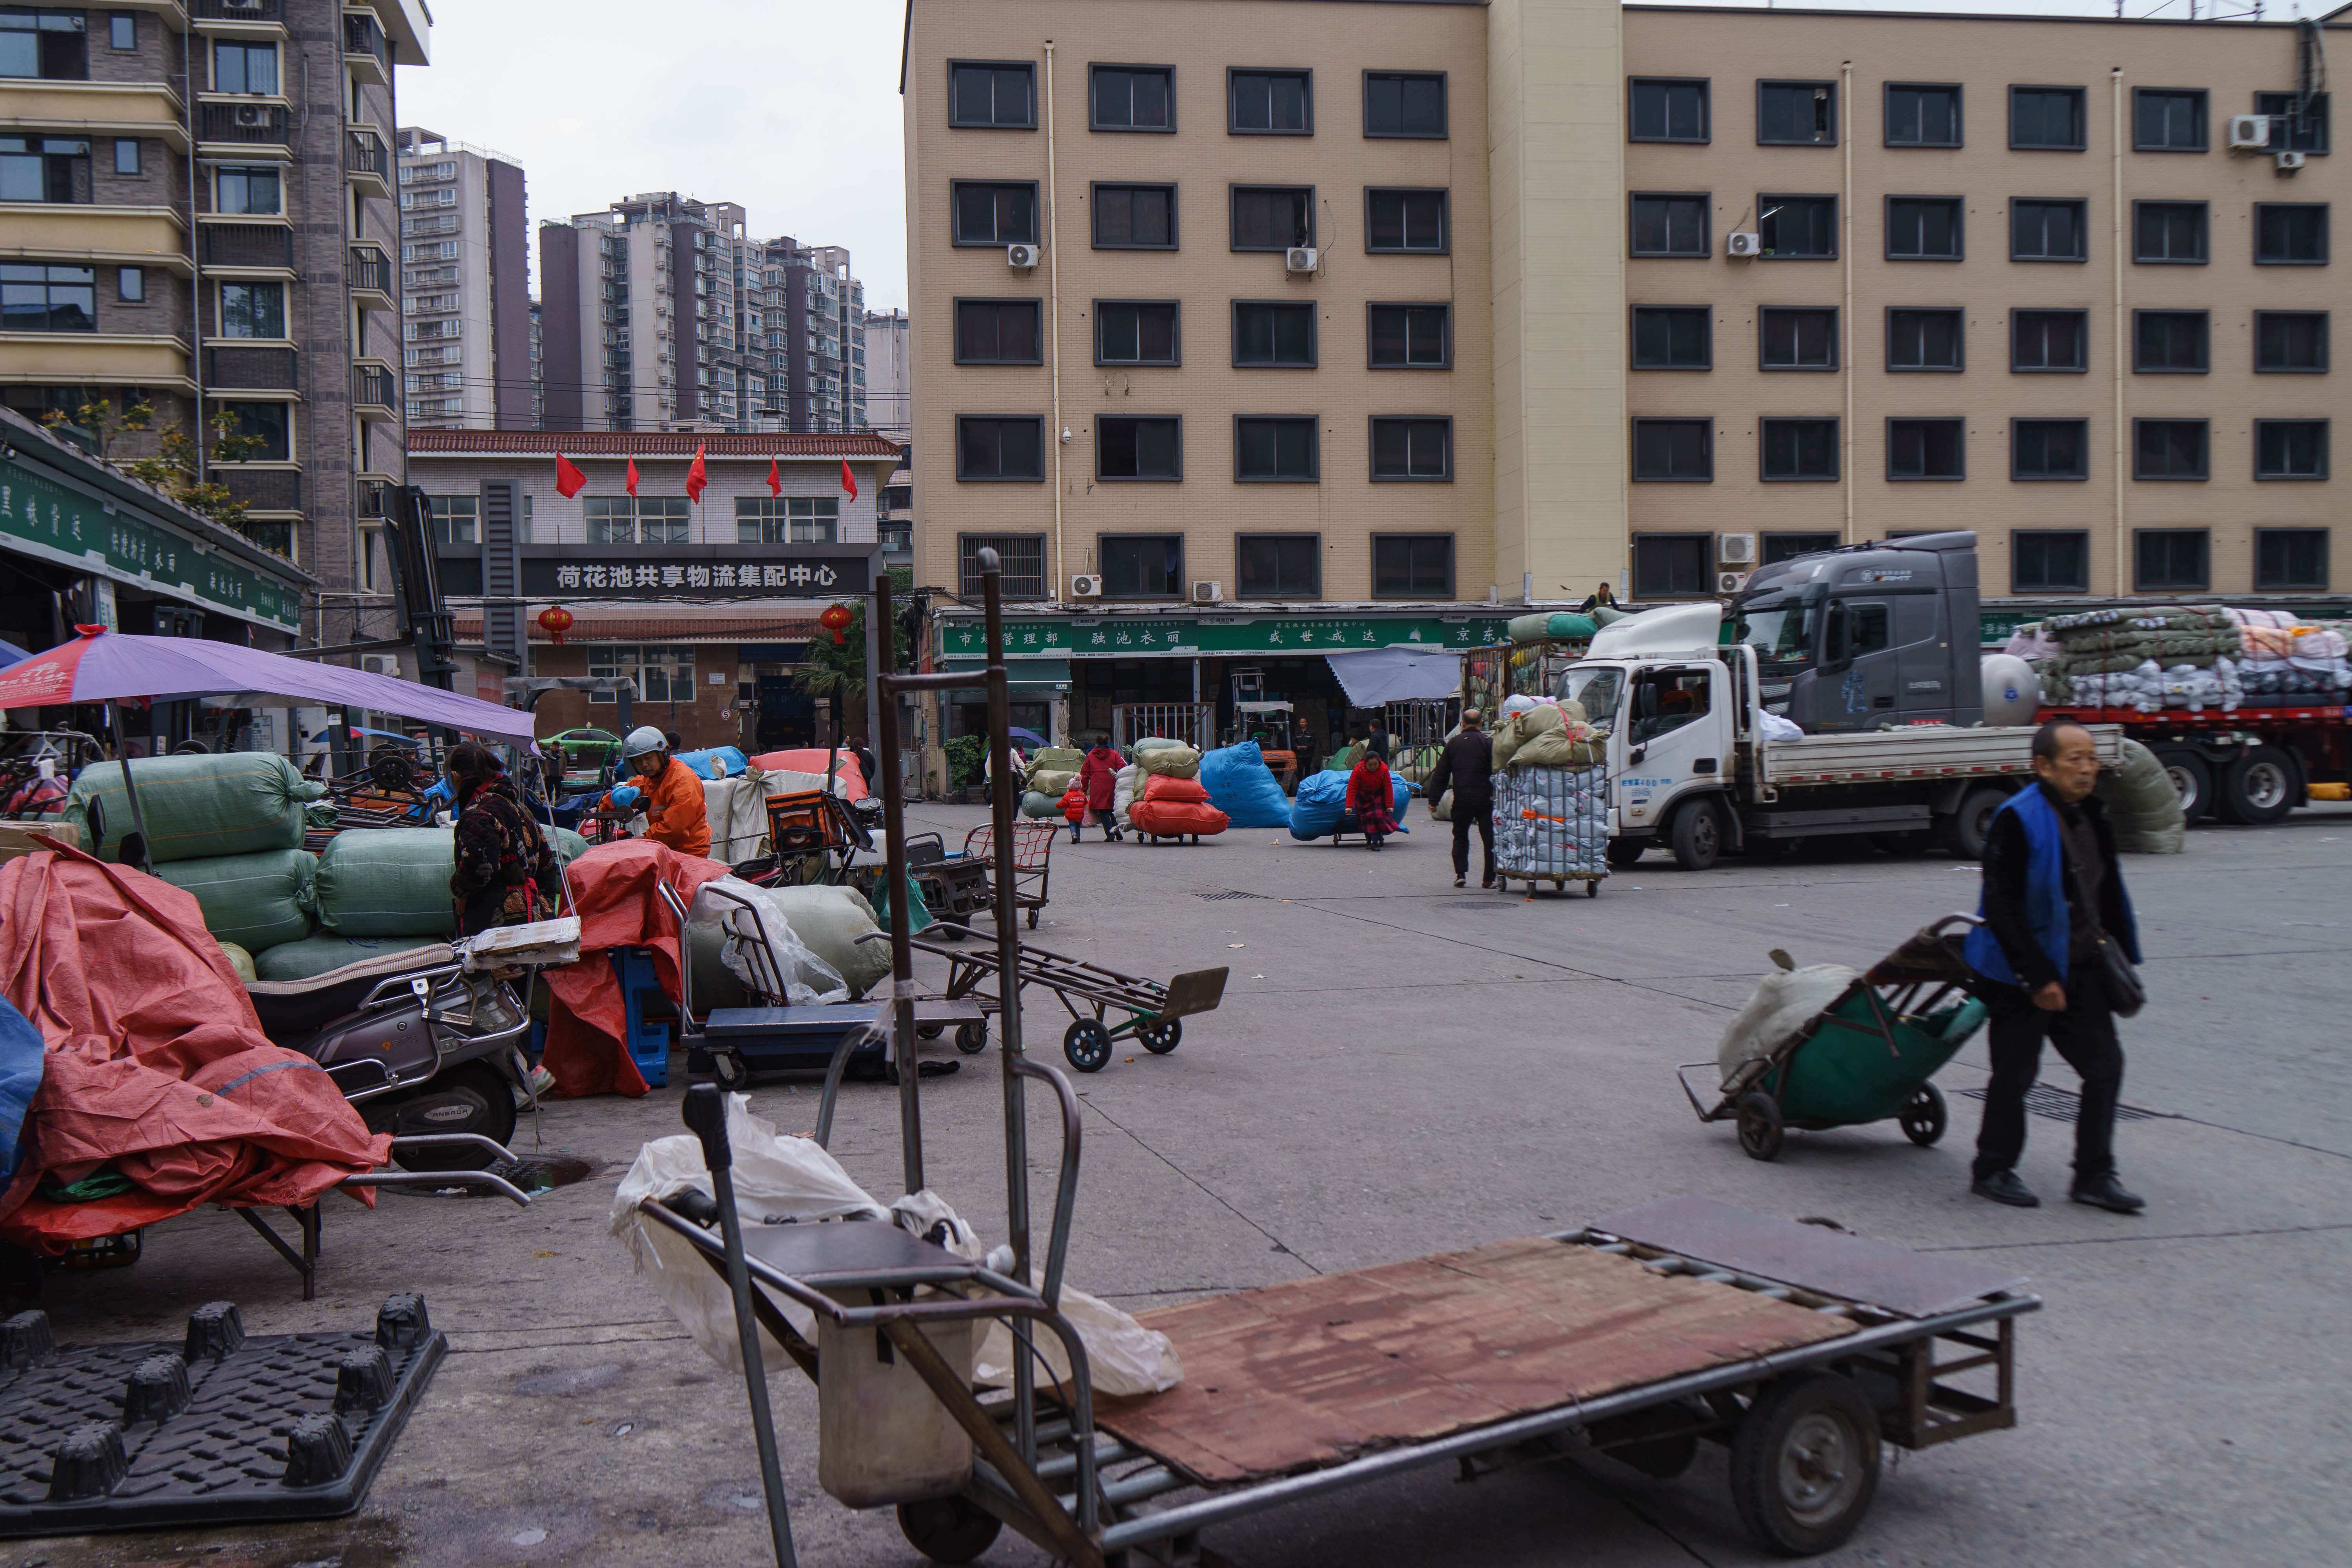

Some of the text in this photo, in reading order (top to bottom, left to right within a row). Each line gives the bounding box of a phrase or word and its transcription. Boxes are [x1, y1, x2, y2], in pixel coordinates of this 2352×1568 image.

[557, 564, 837, 588] 荷花池共享物流集配中心
[1091, 630, 1180, 645] 融池衣丽
[1269, 629, 1376, 644] 盛世成达
[1456, 626, 1495, 642] 京东
